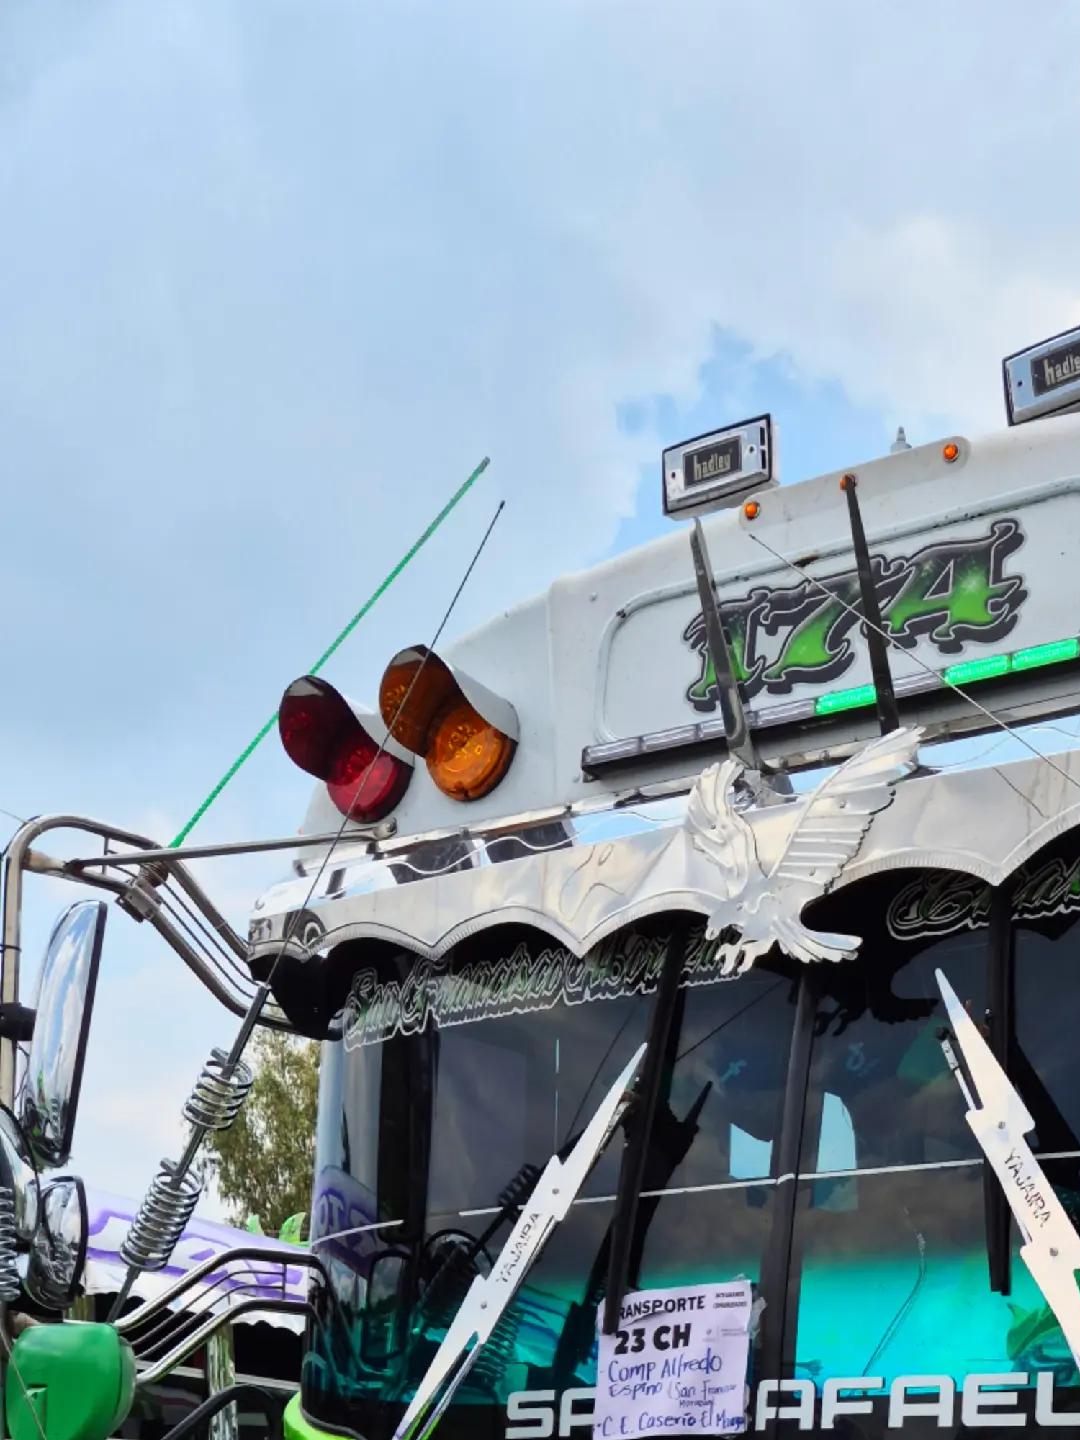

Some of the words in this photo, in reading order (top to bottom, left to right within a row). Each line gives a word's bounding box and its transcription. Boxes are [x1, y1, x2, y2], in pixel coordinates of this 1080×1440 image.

[692, 453, 731, 481] hadley
[683, 520, 1026, 711] 174
[1003, 1147, 1052, 1228] YAJAIRA
[619, 1296, 706, 1320] RANSPORTE
[614, 1328, 646, 1355] 23
[653, 1323, 692, 1351] CH
[661, 1347, 722, 1378] Alfredo
[505, 1387, 597, 1440] SA
